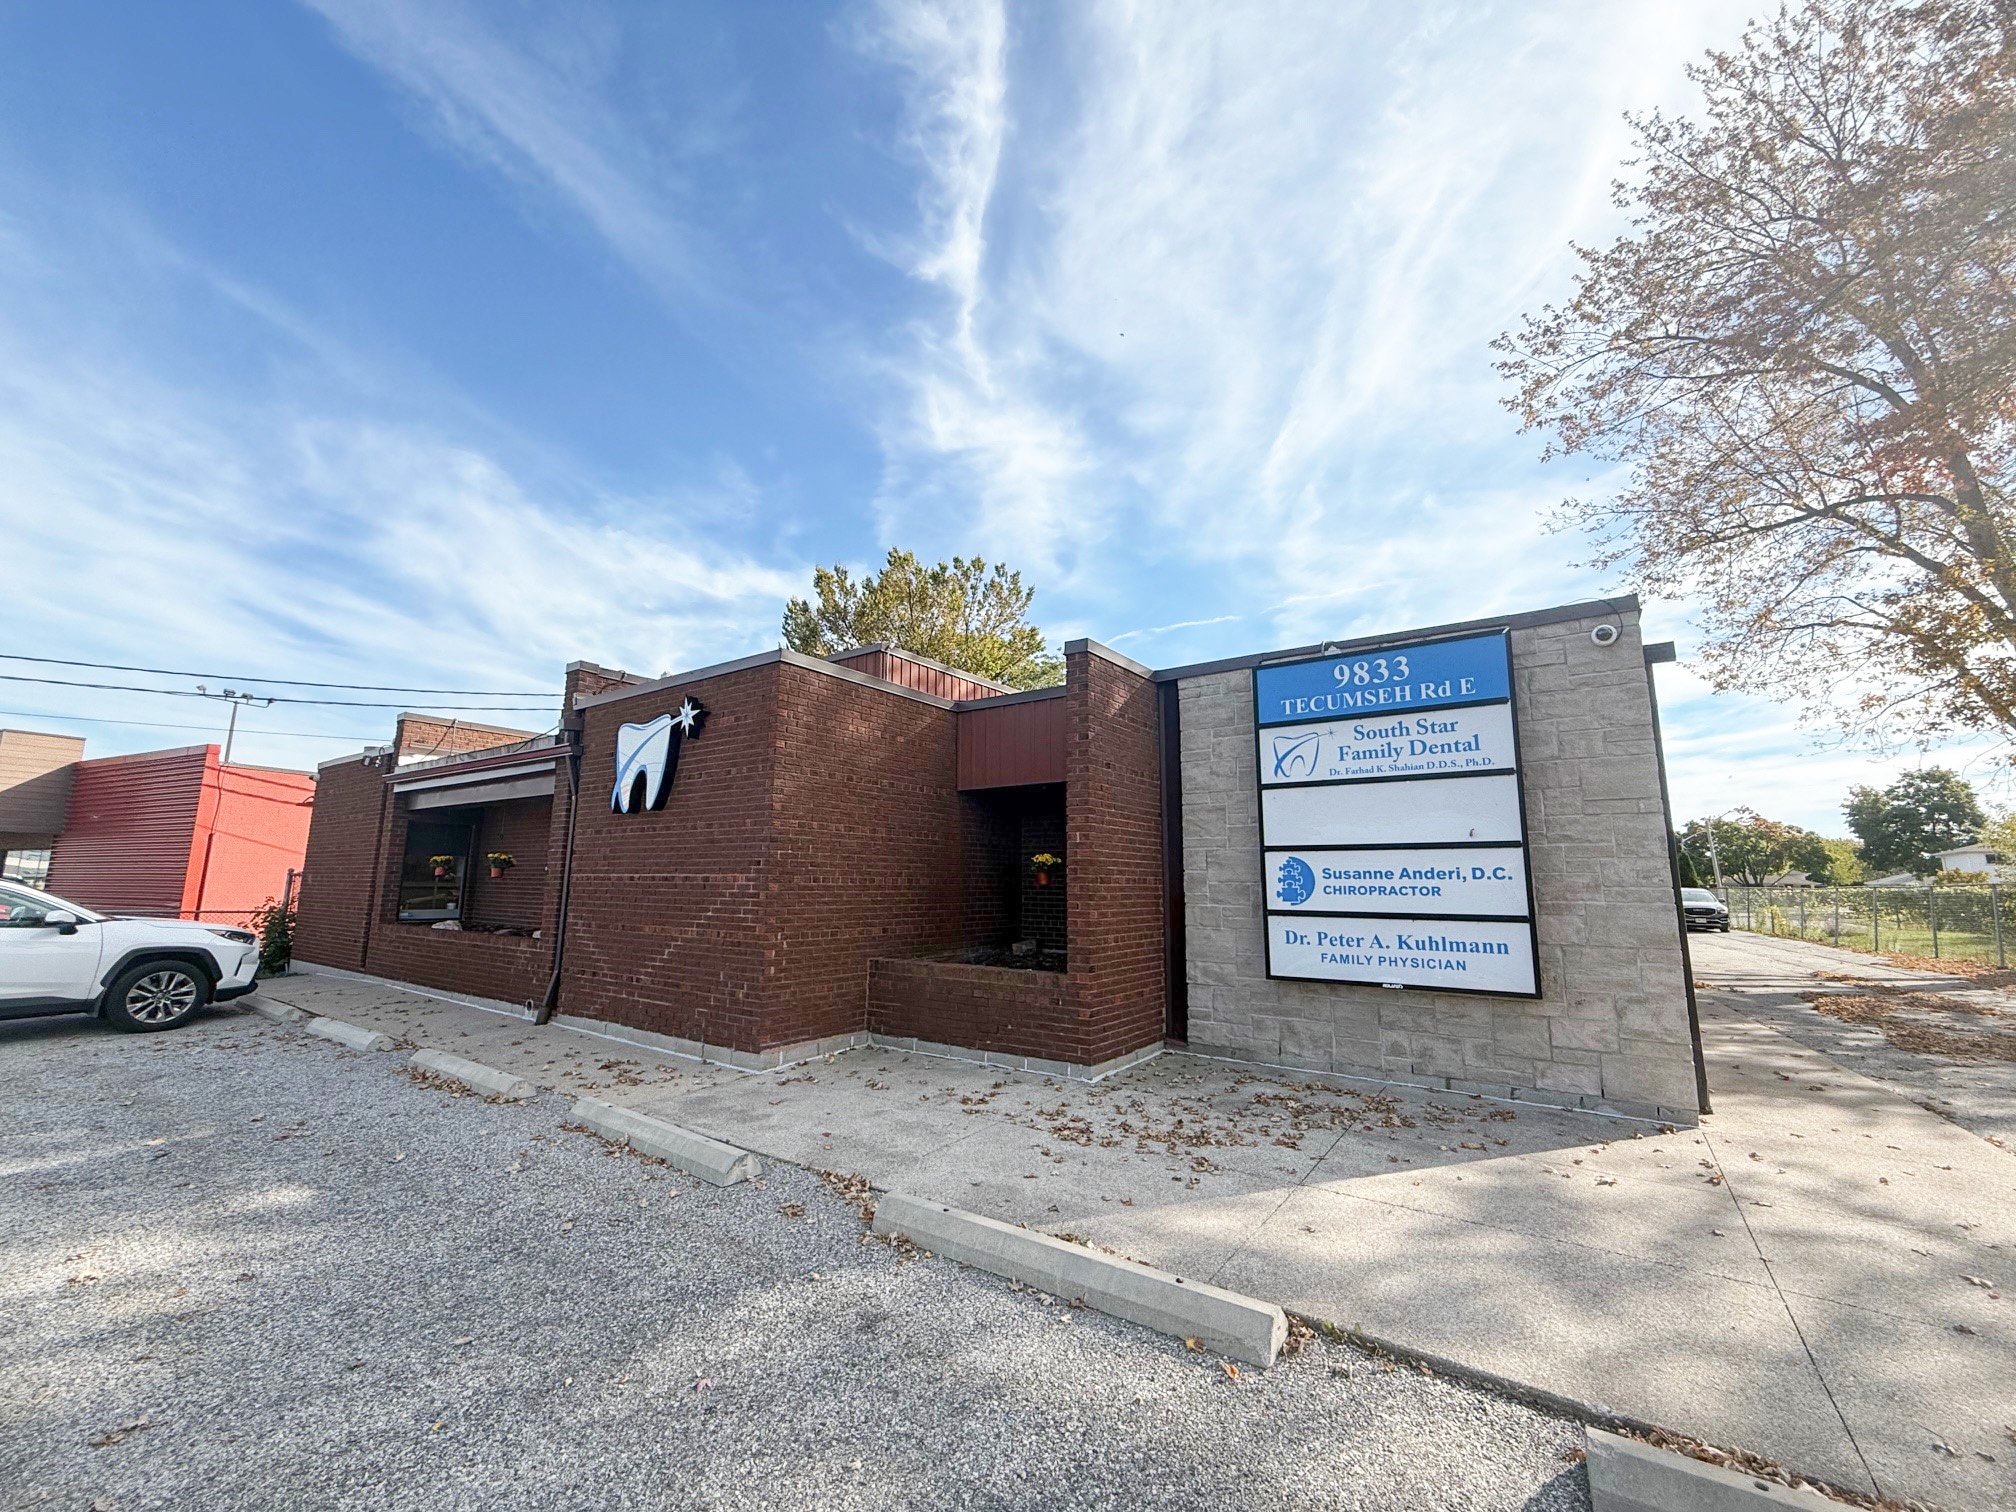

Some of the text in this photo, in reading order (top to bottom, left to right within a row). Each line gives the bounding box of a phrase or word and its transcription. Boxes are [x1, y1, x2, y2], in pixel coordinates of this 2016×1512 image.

[1333, 655, 1410, 689] 9833
[1281, 677, 1476, 715] TECUMSEH Rd E
[1353, 718, 1459, 741] South Star
[1337, 734, 1481, 763] Family Dental
[1329, 757, 1495, 776] Dr. Farhad K. Shahian D.D.S., Ph.D.
[1322, 867, 1513, 883] Susanne Anderi, D.C.
[1323, 885, 1442, 897] CHIROPRACTOR
[1284, 929, 1510, 955] Dr. Peter A. Kuhlmann
[1320, 953, 1467, 971] FAMILY PHYSICIAN
